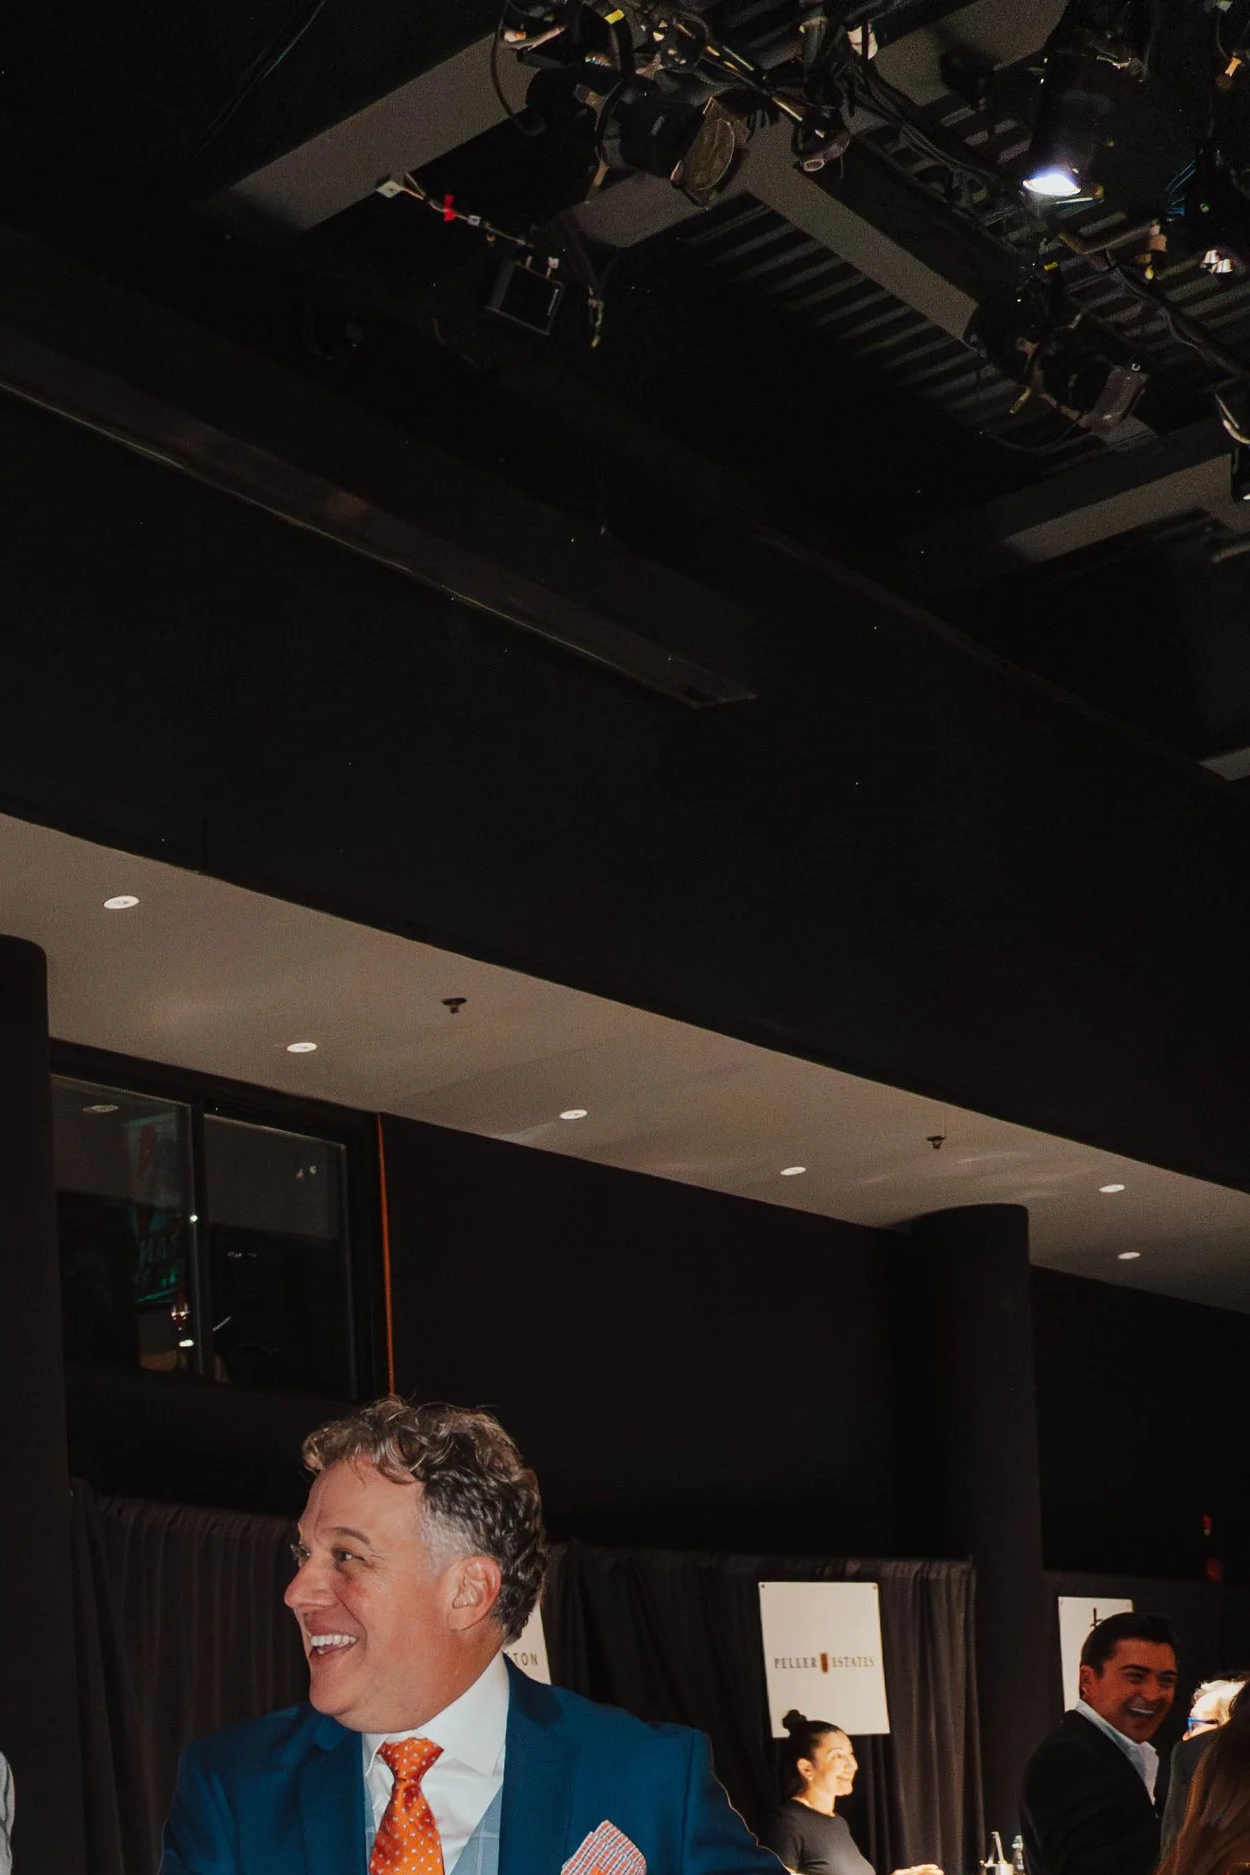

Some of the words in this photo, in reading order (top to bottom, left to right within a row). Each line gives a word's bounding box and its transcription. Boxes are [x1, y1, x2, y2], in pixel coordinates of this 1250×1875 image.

[510, 1652, 538, 1667] TON
[774, 1657, 817, 1669] PELLER
[832, 1656, 875, 1668] ESTATES
